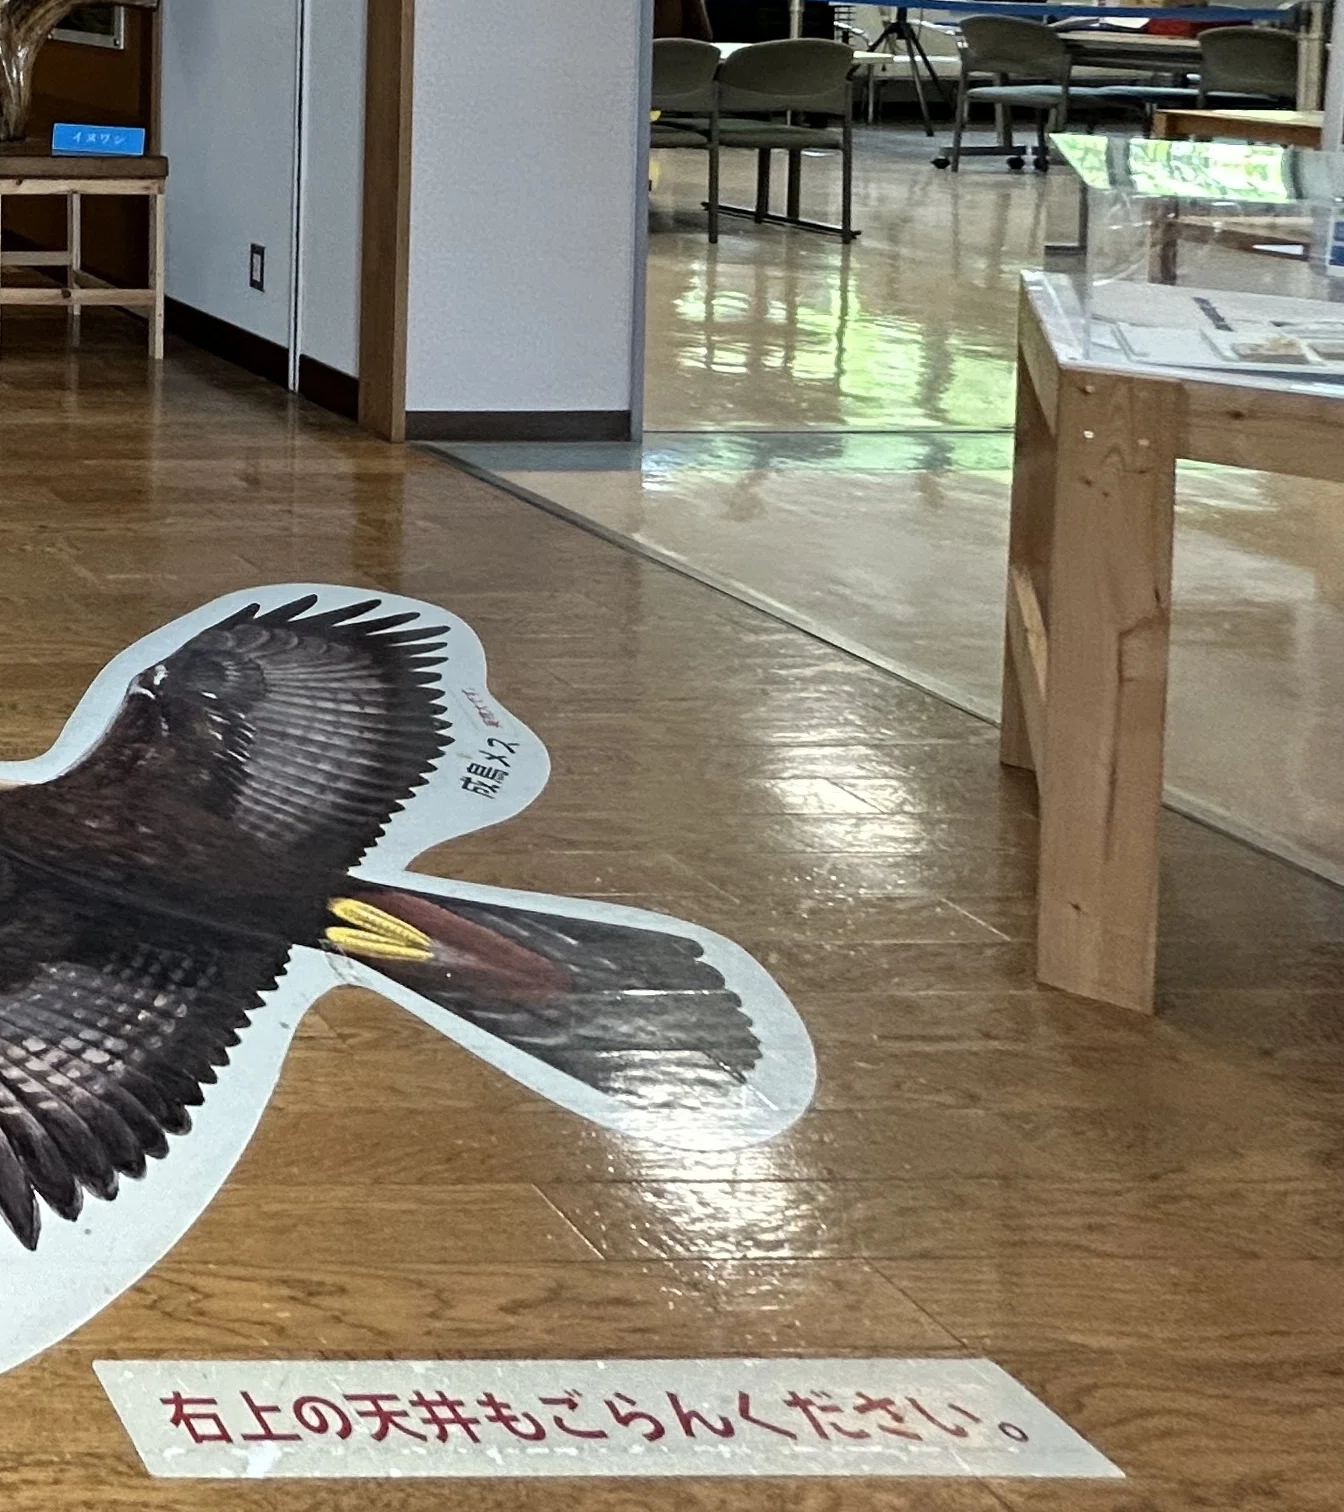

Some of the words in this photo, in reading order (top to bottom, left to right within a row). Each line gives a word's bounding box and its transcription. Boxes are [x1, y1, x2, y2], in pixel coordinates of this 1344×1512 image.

[459, 737, 520, 800] 成鳥メス
[160, 1388, 1030, 1445] 右上の天井もごらんください。
